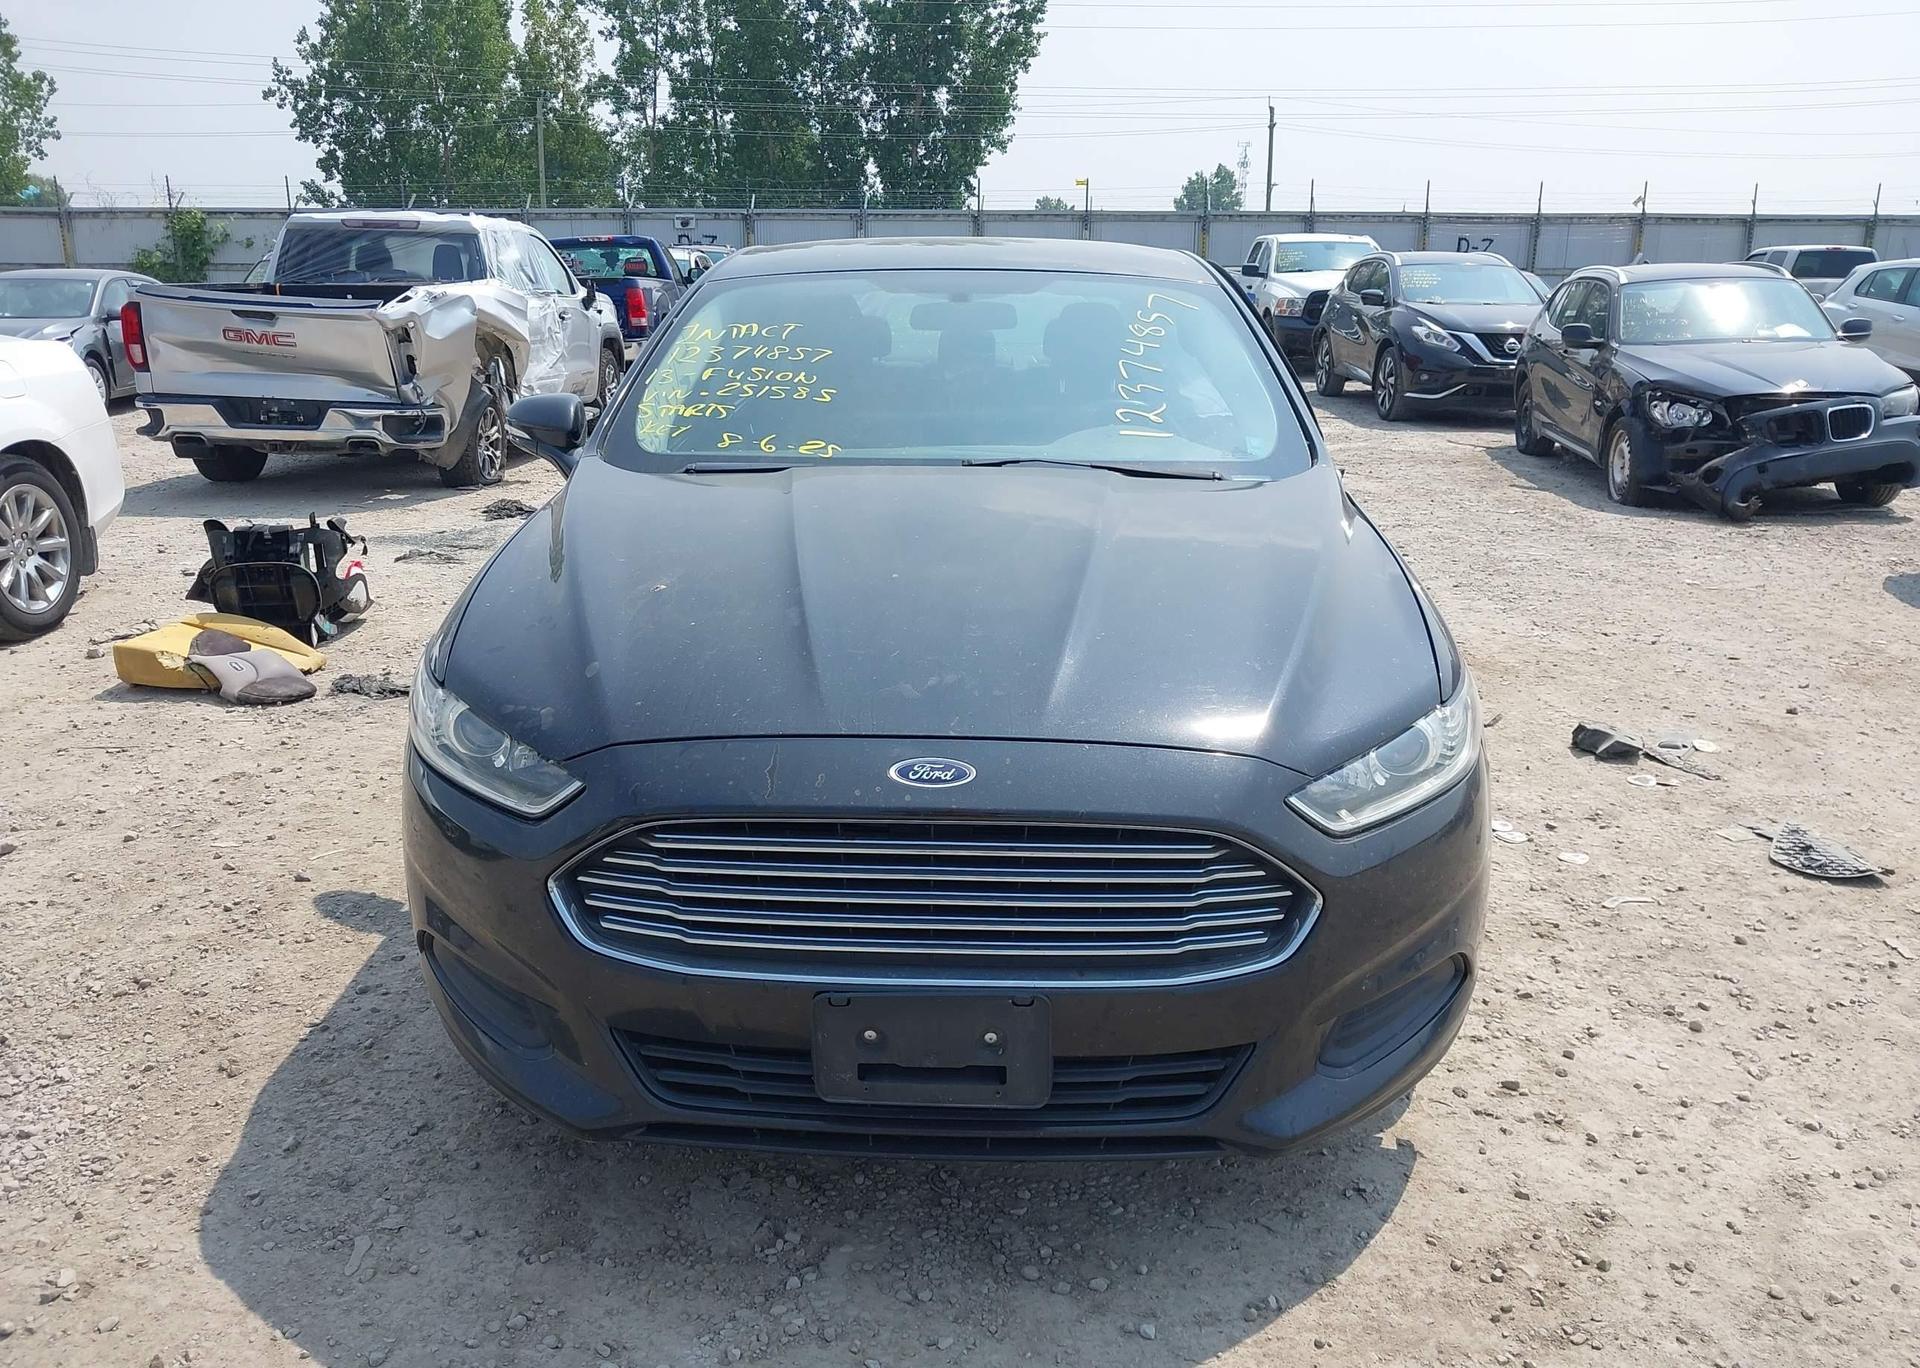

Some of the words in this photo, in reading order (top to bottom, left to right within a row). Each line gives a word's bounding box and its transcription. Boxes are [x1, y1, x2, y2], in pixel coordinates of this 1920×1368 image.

[1456, 237, 1494, 253] D-7
[222, 326, 297, 347] GMC
[676, 323, 803, 345] INTACT
[667, 344, 833, 364] 12374857
[1115, 293, 1200, 437] 12374857
[638, 402, 736, 419] STARTS
[908, 763, 956, 781] Ford
